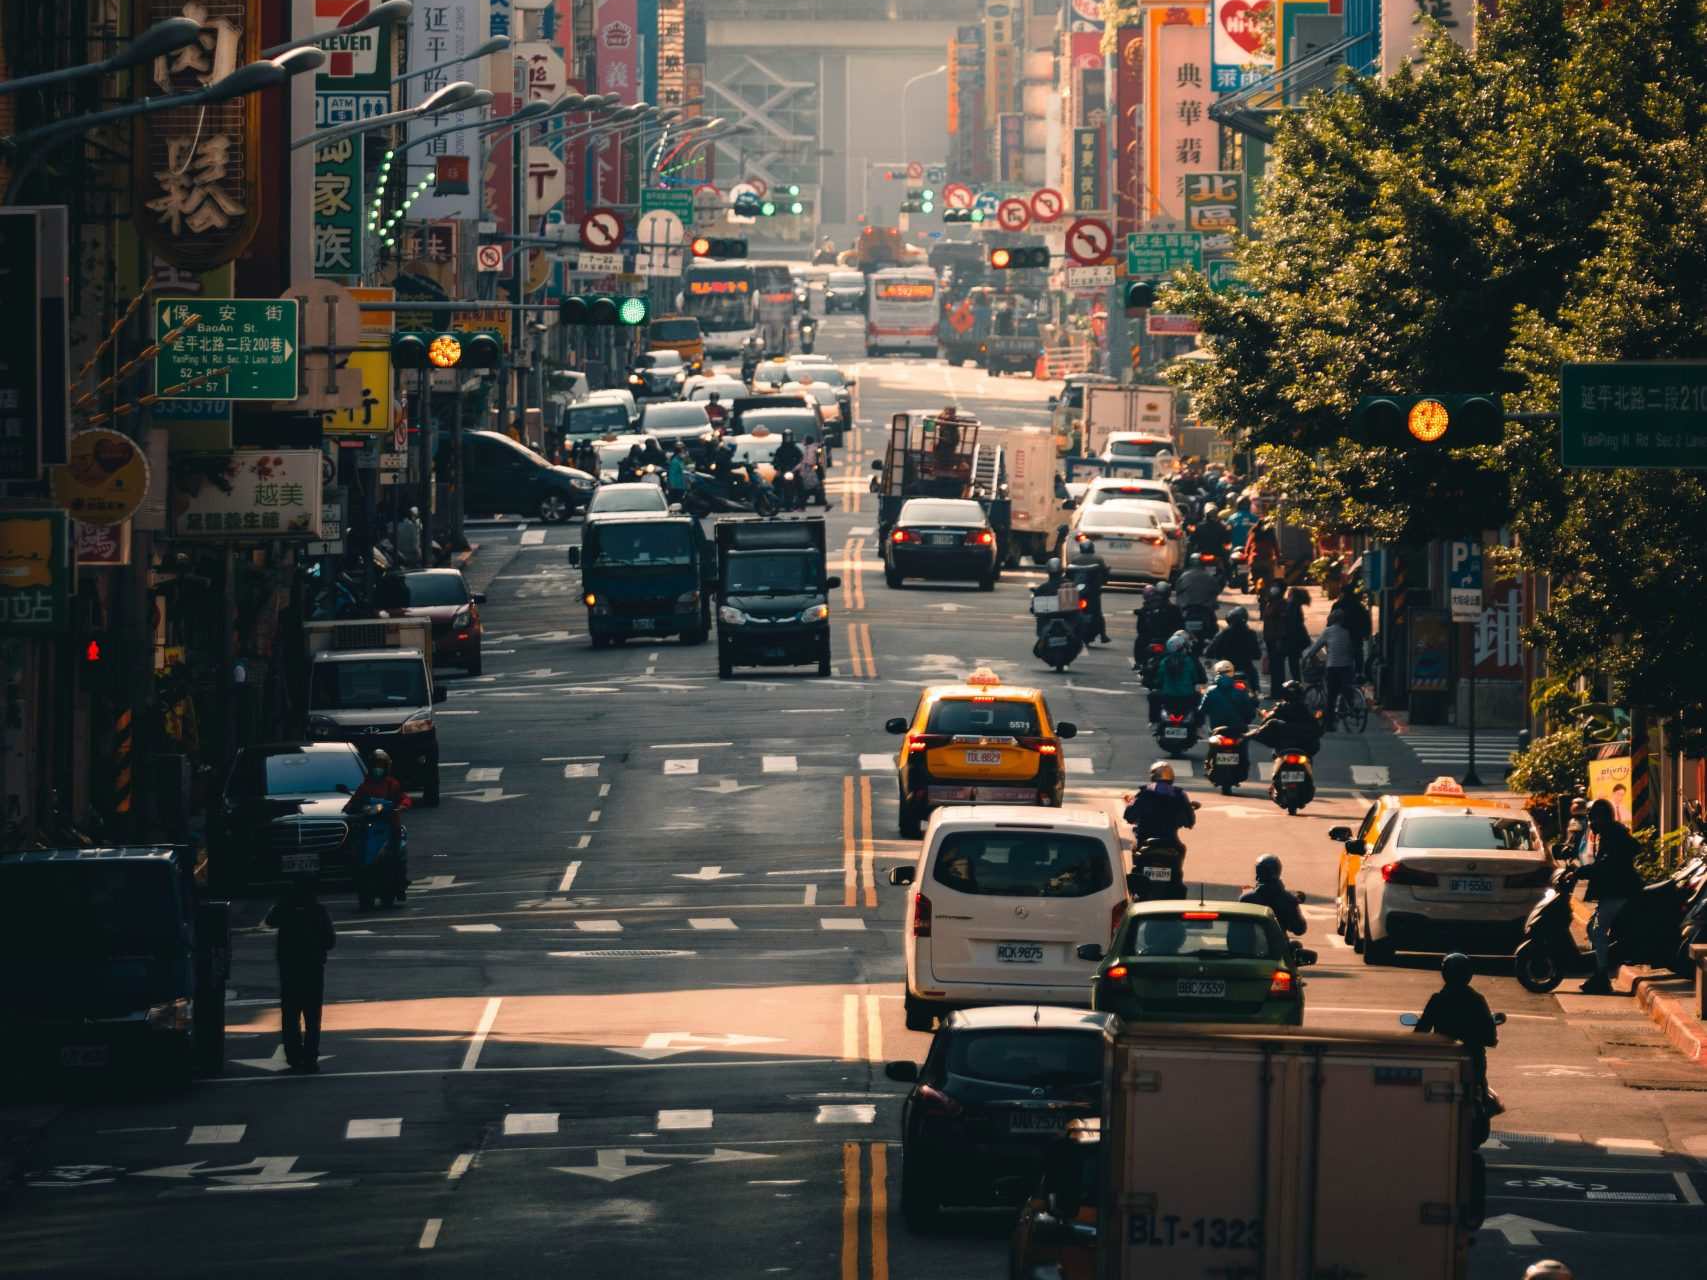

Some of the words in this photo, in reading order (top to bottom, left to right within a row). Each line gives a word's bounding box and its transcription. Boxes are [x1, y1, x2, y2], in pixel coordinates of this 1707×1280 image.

[332, 99, 353, 107] ATM
[173, 305, 283, 321] 保安街
[197, 324, 233, 332] BaoAn
[243, 324, 258, 332] St.
[173, 336, 282, 352] 延平北路二段200巷
[173, 355, 199, 365] YanPing
[227, 355, 241, 363] Sec.
[244, 355, 249, 363] 2
[252, 355, 268, 363] Lane
[271, 355, 283, 363] 200
[181, 369, 192, 377] 52
[206, 383, 218, 391] 57
[1582, 433, 1618, 450] YanPing
[1675, 433, 1681, 447] 2
[255, 485, 303, 508] 越美
[1452, 542, 1468, 572] P
[967, 752, 1001, 763] TDL-8829
[998, 946, 1043, 959] RCK-9875
[1129, 1216, 1263, 1251] BLT-1323
